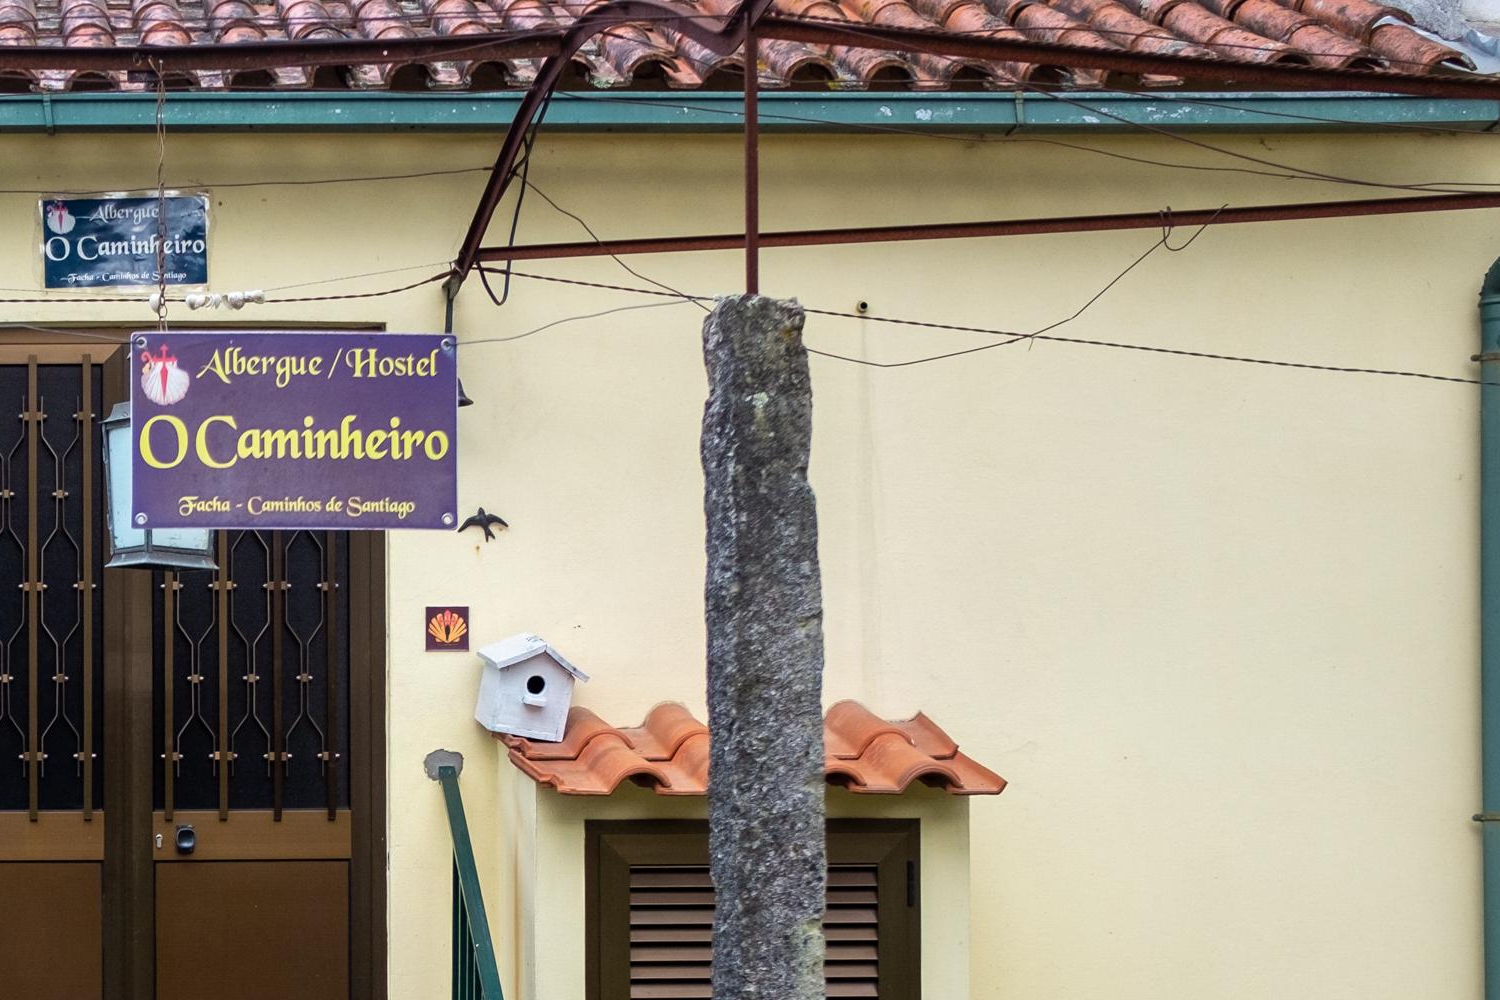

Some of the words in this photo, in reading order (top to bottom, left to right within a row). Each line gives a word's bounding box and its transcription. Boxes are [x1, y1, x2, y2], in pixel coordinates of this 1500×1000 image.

[89, 204, 159, 225] Albergue
[46, 236, 71, 262] O
[77, 234, 205, 261] Caminheiro
[67, 272, 94, 283] Facha
[141, 270, 150, 279] de
[151, 270, 187, 282] Sntiago
[196, 347, 323, 389] Albergue
[345, 347, 440, 378] Hostel
[139, 415, 189, 470] O
[195, 415, 449, 470] Caminheiro
[178, 495, 231, 517] Facha
[247, 496, 322, 516] Caminhos
[325, 497, 343, 513] de
[346, 496, 416, 518] Santiago
